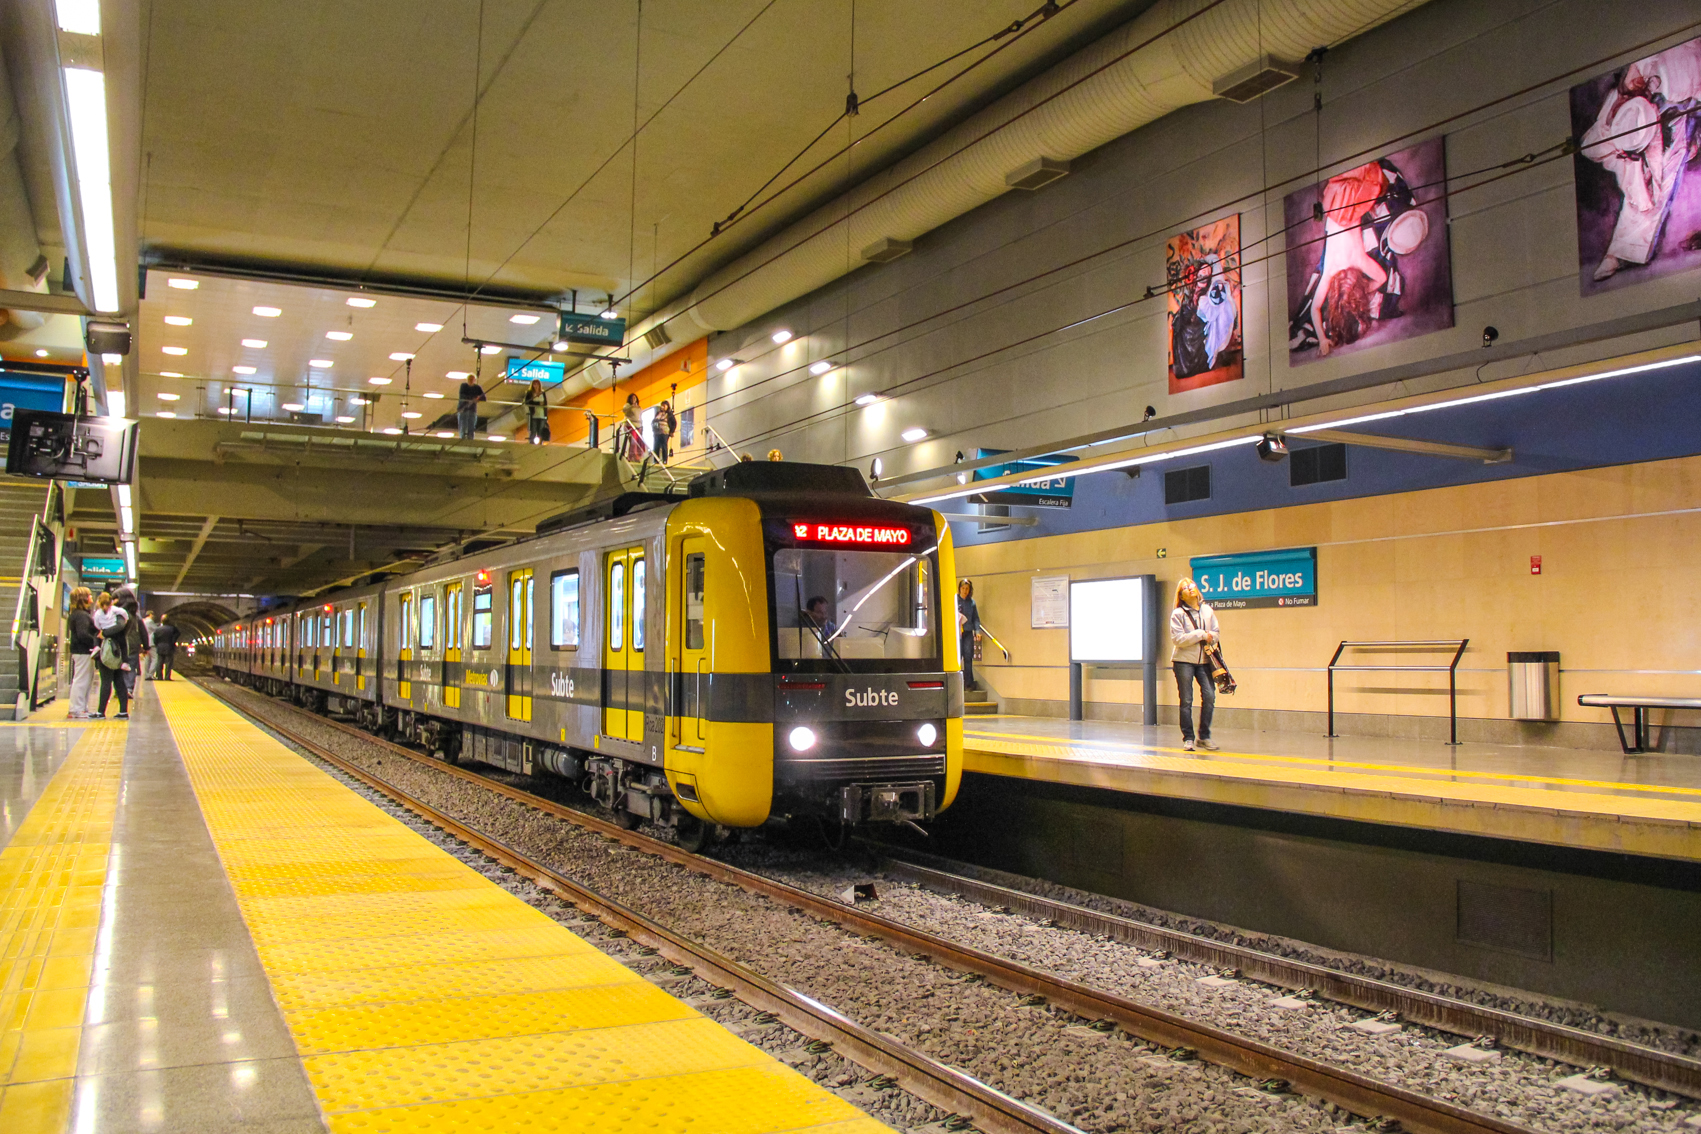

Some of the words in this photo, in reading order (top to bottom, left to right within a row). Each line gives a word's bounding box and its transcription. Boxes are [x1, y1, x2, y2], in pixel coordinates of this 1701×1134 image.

[577, 324, 608, 337] Salida
[521, 368, 549, 379] Salida
[1038, 498, 1059, 506] Escalera
[818, 526, 855, 541] PLAZA
[856, 528, 873, 542] DE
[874, 529, 908, 543] MAYO
[1201, 575, 1213, 592] S.
[1217, 574, 1228, 592] J.
[1232, 571, 1251, 591] de
[1256, 570, 1303, 589] Flores
[1226, 600, 1232, 608] de
[1233, 600, 1247, 608] Mayo
[1285, 597, 1293, 605] No
[1294, 597, 1309, 605] Fumar
[551, 671, 574, 698] Subte
[845, 687, 899, 707] Subte
[651, 746, 657, 761] B
